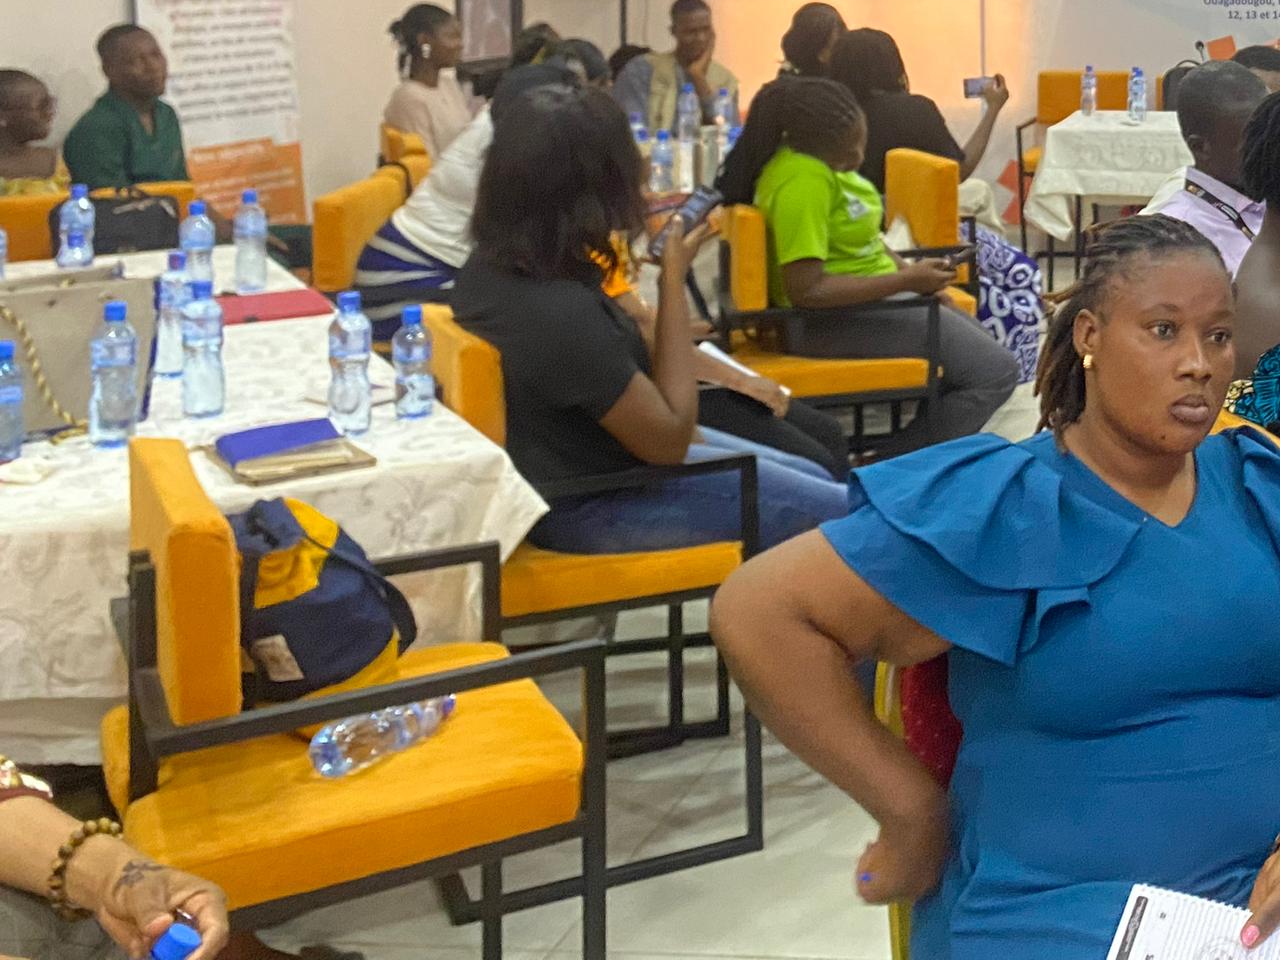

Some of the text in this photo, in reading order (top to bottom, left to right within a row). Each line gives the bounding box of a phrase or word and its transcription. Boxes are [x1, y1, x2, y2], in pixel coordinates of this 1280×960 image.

[1228, 11, 1242, 20] 12,
[1246, 11, 1257, 19] 13
[1259, 11, 1270, 19] et
